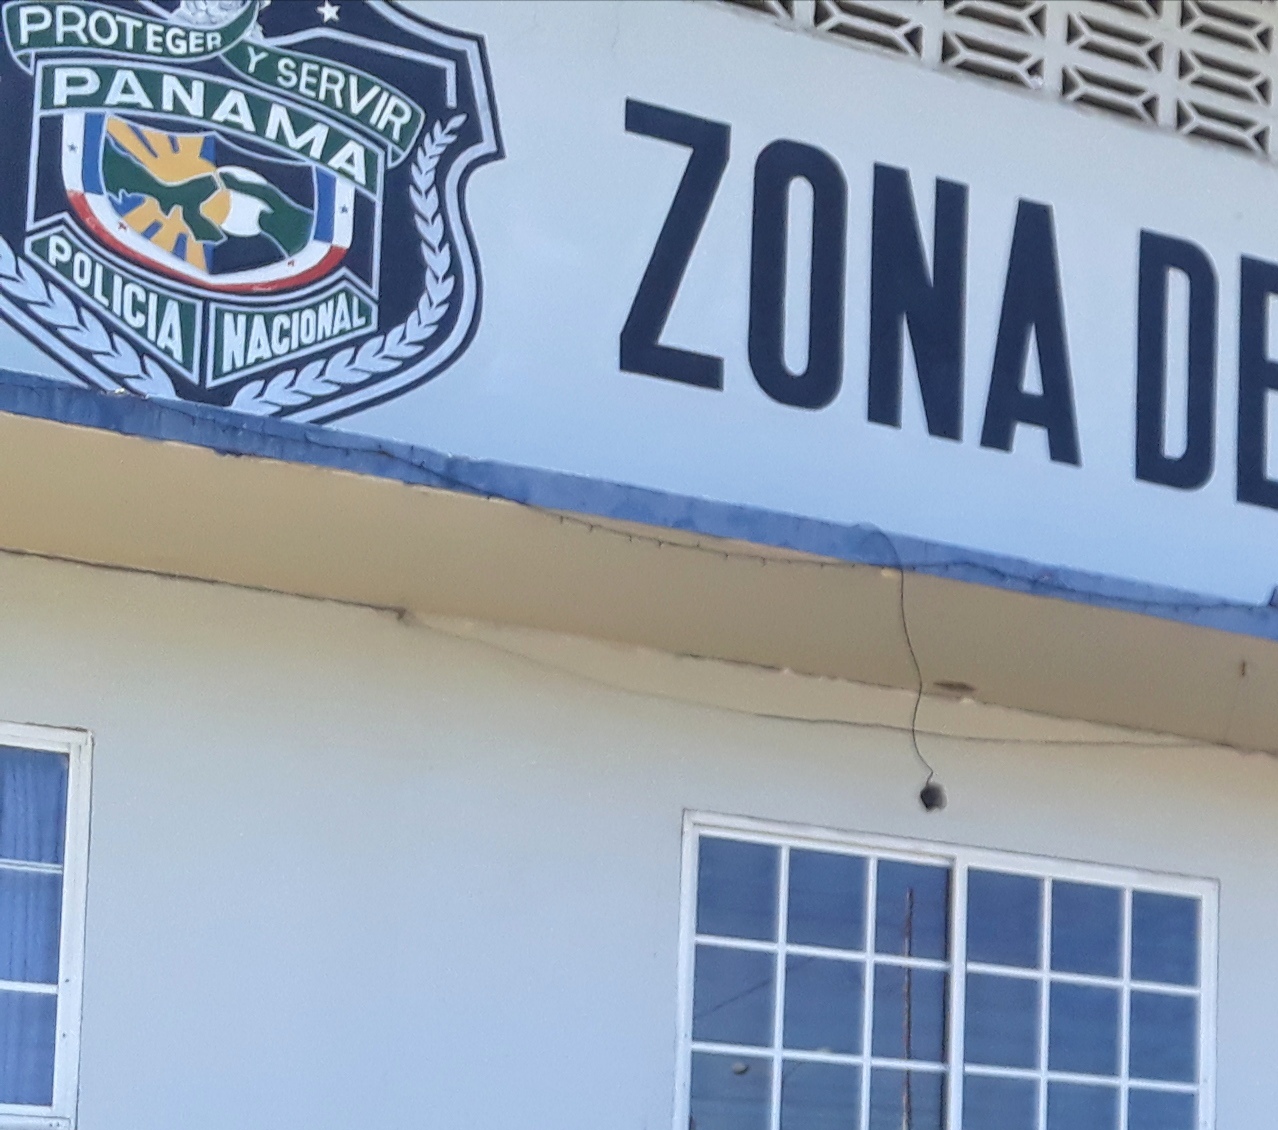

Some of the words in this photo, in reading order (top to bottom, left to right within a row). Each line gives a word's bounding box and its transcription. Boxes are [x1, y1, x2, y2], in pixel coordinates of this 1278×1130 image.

[19, 5, 222, 53] PROTEGER
[246, 51, 263, 73] Y
[277, 57, 414, 143] SERVIR
[53, 67, 367, 187] PANAMA
[47, 234, 184, 364] POLICIA
[222, 292, 367, 372] NACIONAL
[619, 96, 1082, 468] ZONA
